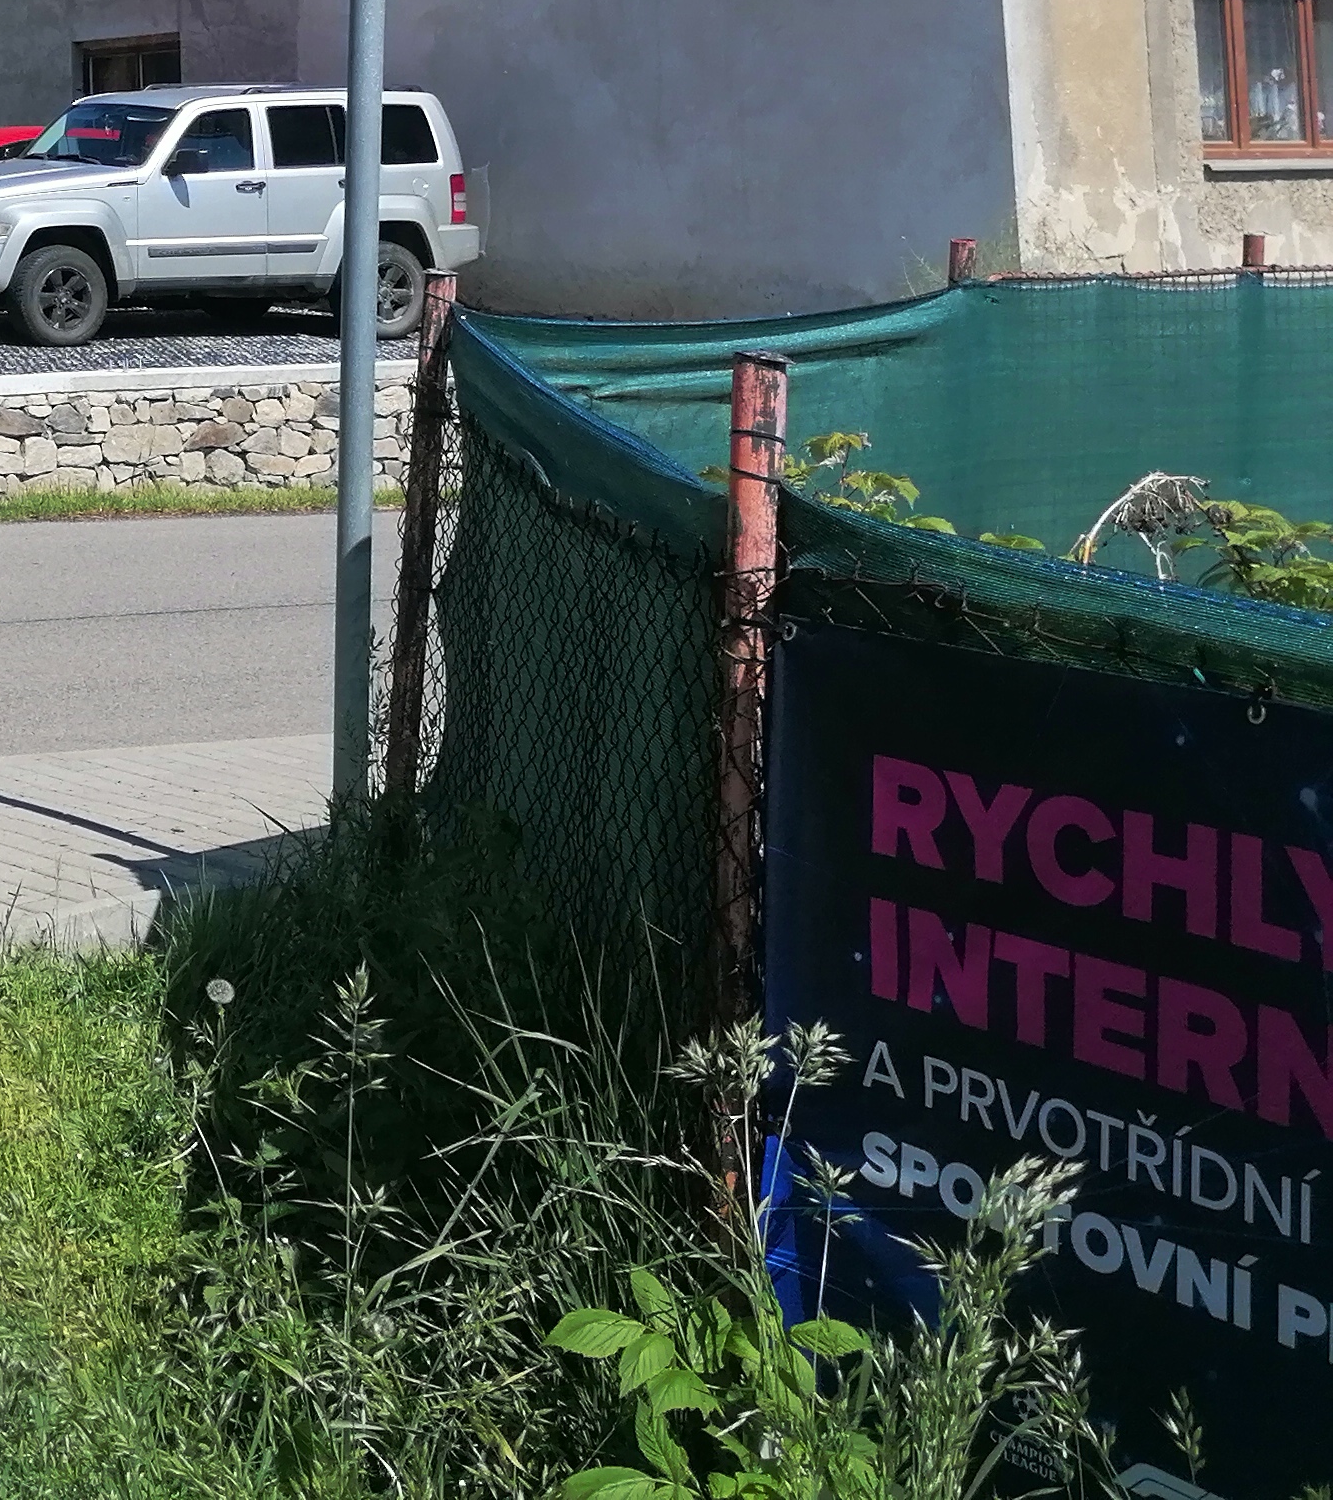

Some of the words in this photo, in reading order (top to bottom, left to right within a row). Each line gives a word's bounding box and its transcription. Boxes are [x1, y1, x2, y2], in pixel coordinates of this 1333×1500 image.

[870, 897, 1333, 1143] INTERN
[863, 1040, 905, 1099] A
[924, 1057, 1322, 1244] PRVOTŘÍDNÍ
[1279, 1283, 1333, 1366] P
[1003, 1448, 1058, 1483] LEAGUE
